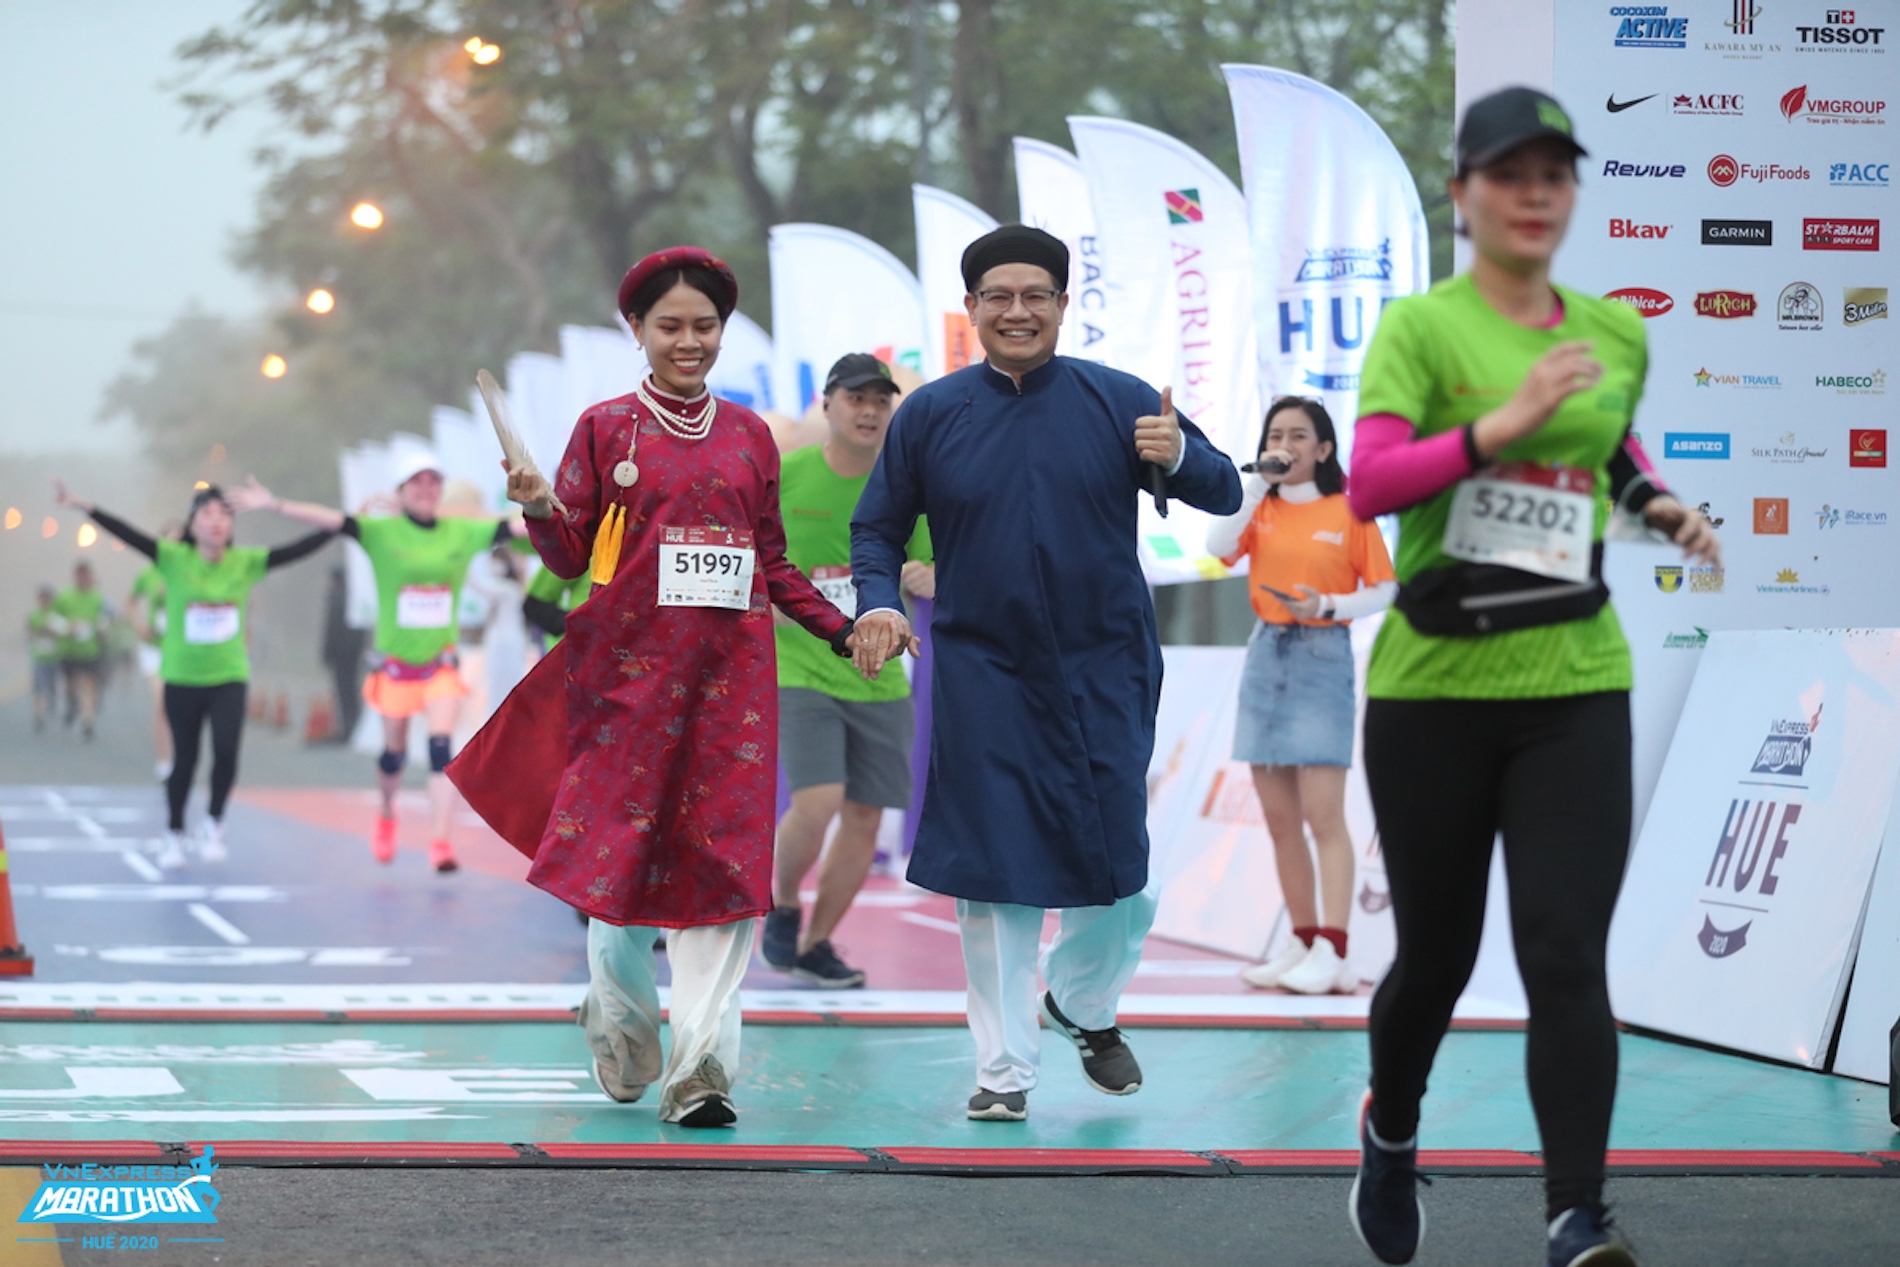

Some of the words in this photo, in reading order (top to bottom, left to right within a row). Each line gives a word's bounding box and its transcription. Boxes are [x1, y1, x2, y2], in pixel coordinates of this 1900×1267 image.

[1609, 6, 1668, 16] COCOXIM
[1616, 17, 1689, 39] ACTIVE
[1796, 27, 1885, 45] TISSOT
[1704, 42, 1746, 52] KAWARA
[1749, 43, 1764, 52] MY
[1769, 44, 1782, 53] AN
[1694, 94, 1744, 110] ACFC
[1807, 101, 1886, 114] VMGROUP
[1603, 160, 1686, 178] Revive
[1849, 164, 1890, 182] ACC
[1609, 218, 1669, 239] Bkav
[1709, 227, 1765, 238] GARMIN
[1279, 297, 1400, 354] HU
[1171, 240, 1218, 437] AGRIBA
[1714, 376, 1740, 385] VIAN
[1742, 375, 1782, 386] TRAVEL
[1816, 376, 1873, 387] HABECO
[1752, 447, 1772, 457] SILK
[1773, 448, 1797, 457] PATH
[1472, 487, 1578, 535] 52202
[675, 552, 743, 577] 51997
[1705, 798, 1803, 896] HUE
[1709, 934, 1729, 954] 2020
